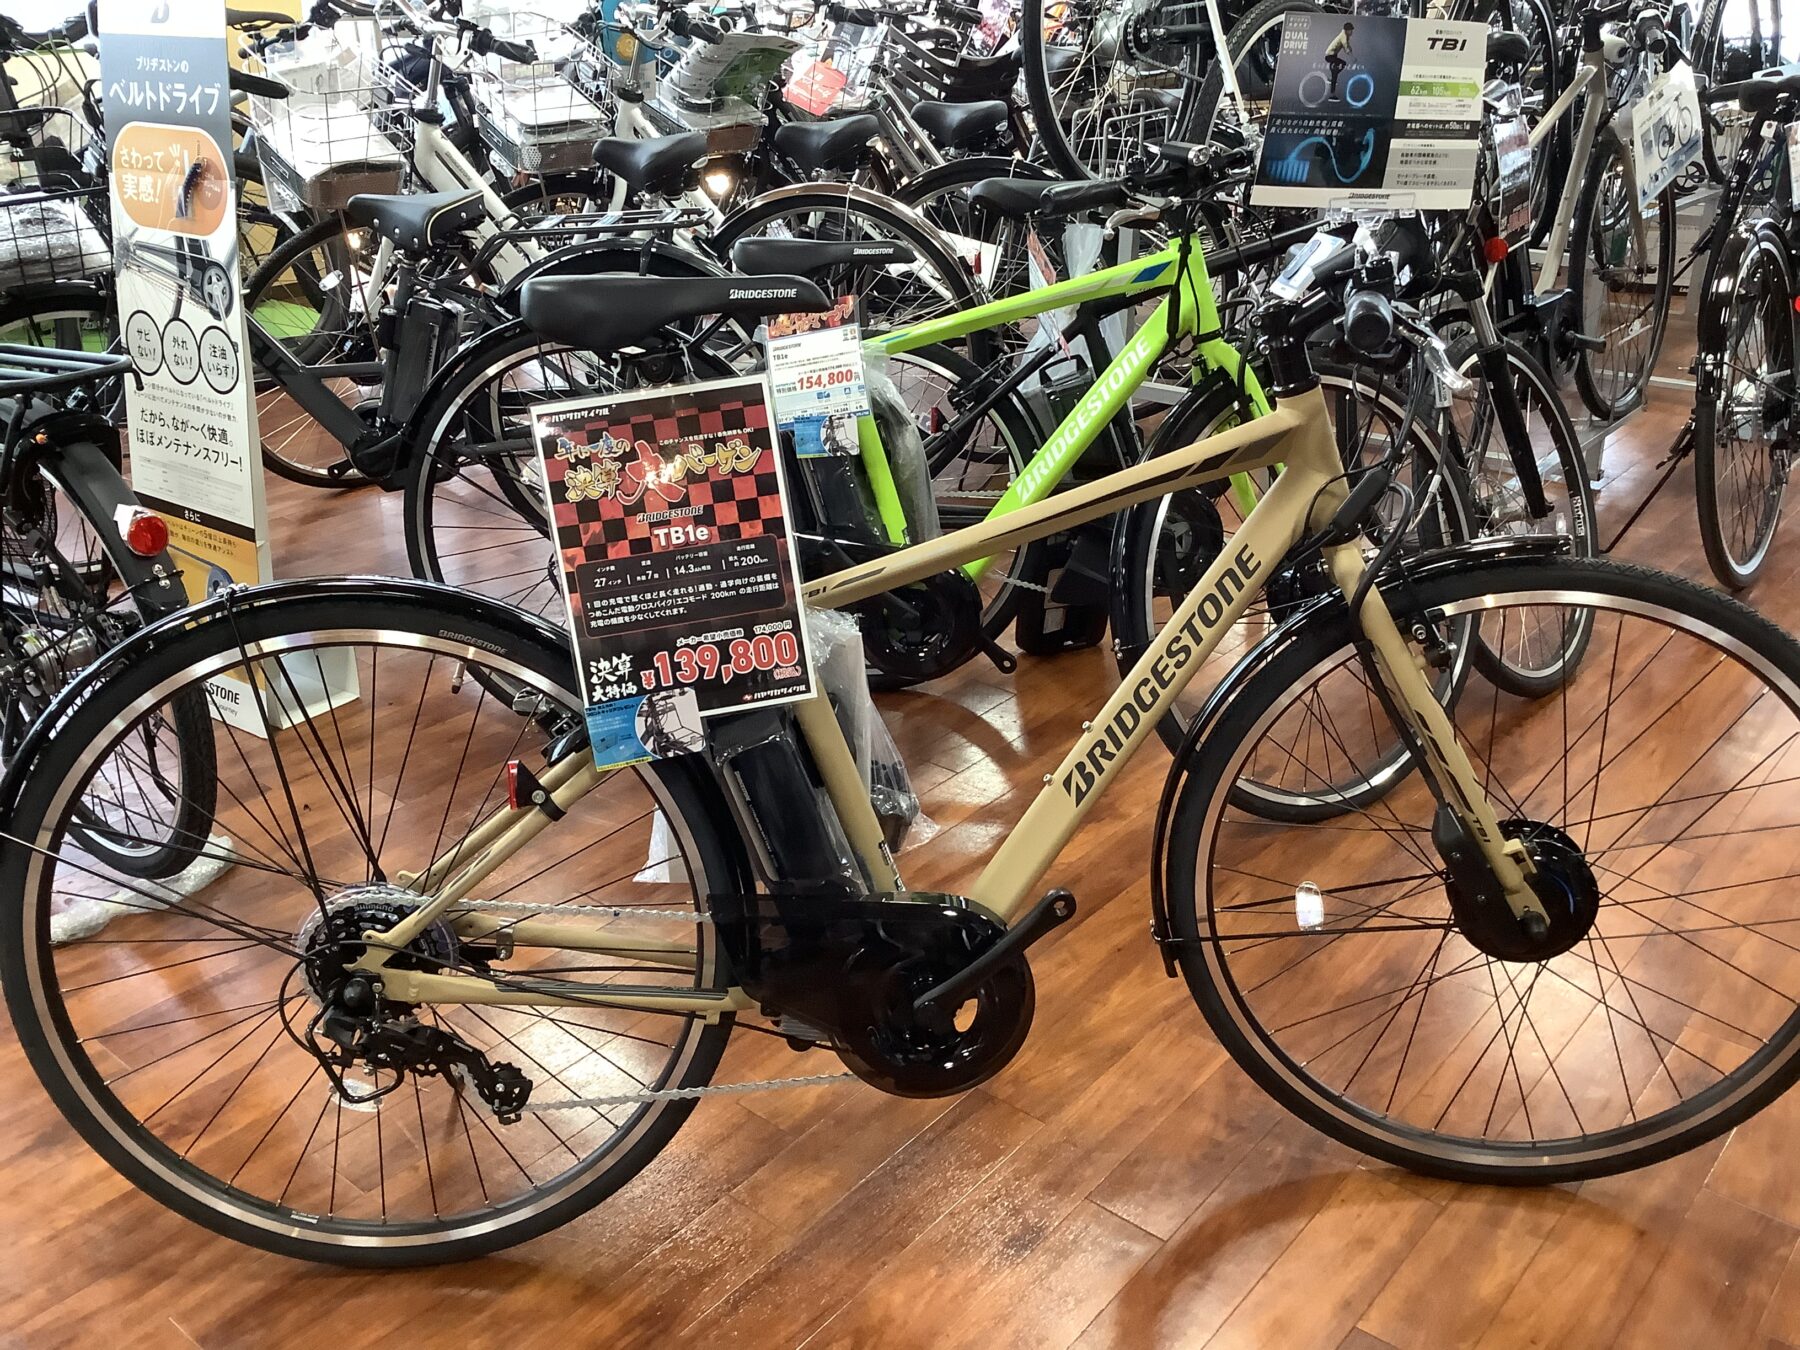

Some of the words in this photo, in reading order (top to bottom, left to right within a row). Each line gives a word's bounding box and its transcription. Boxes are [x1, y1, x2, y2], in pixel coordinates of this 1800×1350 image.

[1284, 31, 1308, 40] DUAL
[1284, 40, 1308, 49] DRIVE
[136, 56, 189, 74] ブリヂストンの
[109, 78, 221, 116] ベルトドライブ
[120, 144, 164, 172] さわって
[122, 173, 162, 203] 実感！
[729, 288, 797, 300] BRIDGESTONE
[136, 328, 151, 342] サビ
[172, 336, 188, 351] 外れ
[138, 345, 156, 361] ない！
[209, 344, 228, 360] 注油
[174, 354, 193, 370] ない！
[207, 362, 235, 380] いらず！
[798, 368, 853, 391] 154,800
[1016, 336, 1151, 504] BRIDGESTONE
[554, 431, 631, 463] 年に一度の
[184, 510, 201, 522] さらに
[636, 504, 704, 524] BRIDGESTONE
[654, 524, 710, 548] TB1e
[593, 578, 606, 588] 27
[710, 589, 736, 600] 200km
[438, 629, 508, 655] BRIDGESTONE
[676, 628, 744, 647] メーカー希望小売価格
[753, 622, 782, 634] 174,000
[589, 652, 634, 686] 決算
[1062, 542, 1262, 809] BRIDGESTONE
[592, 682, 638, 702] 大特価
[354, 904, 394, 912] SHIMANO
